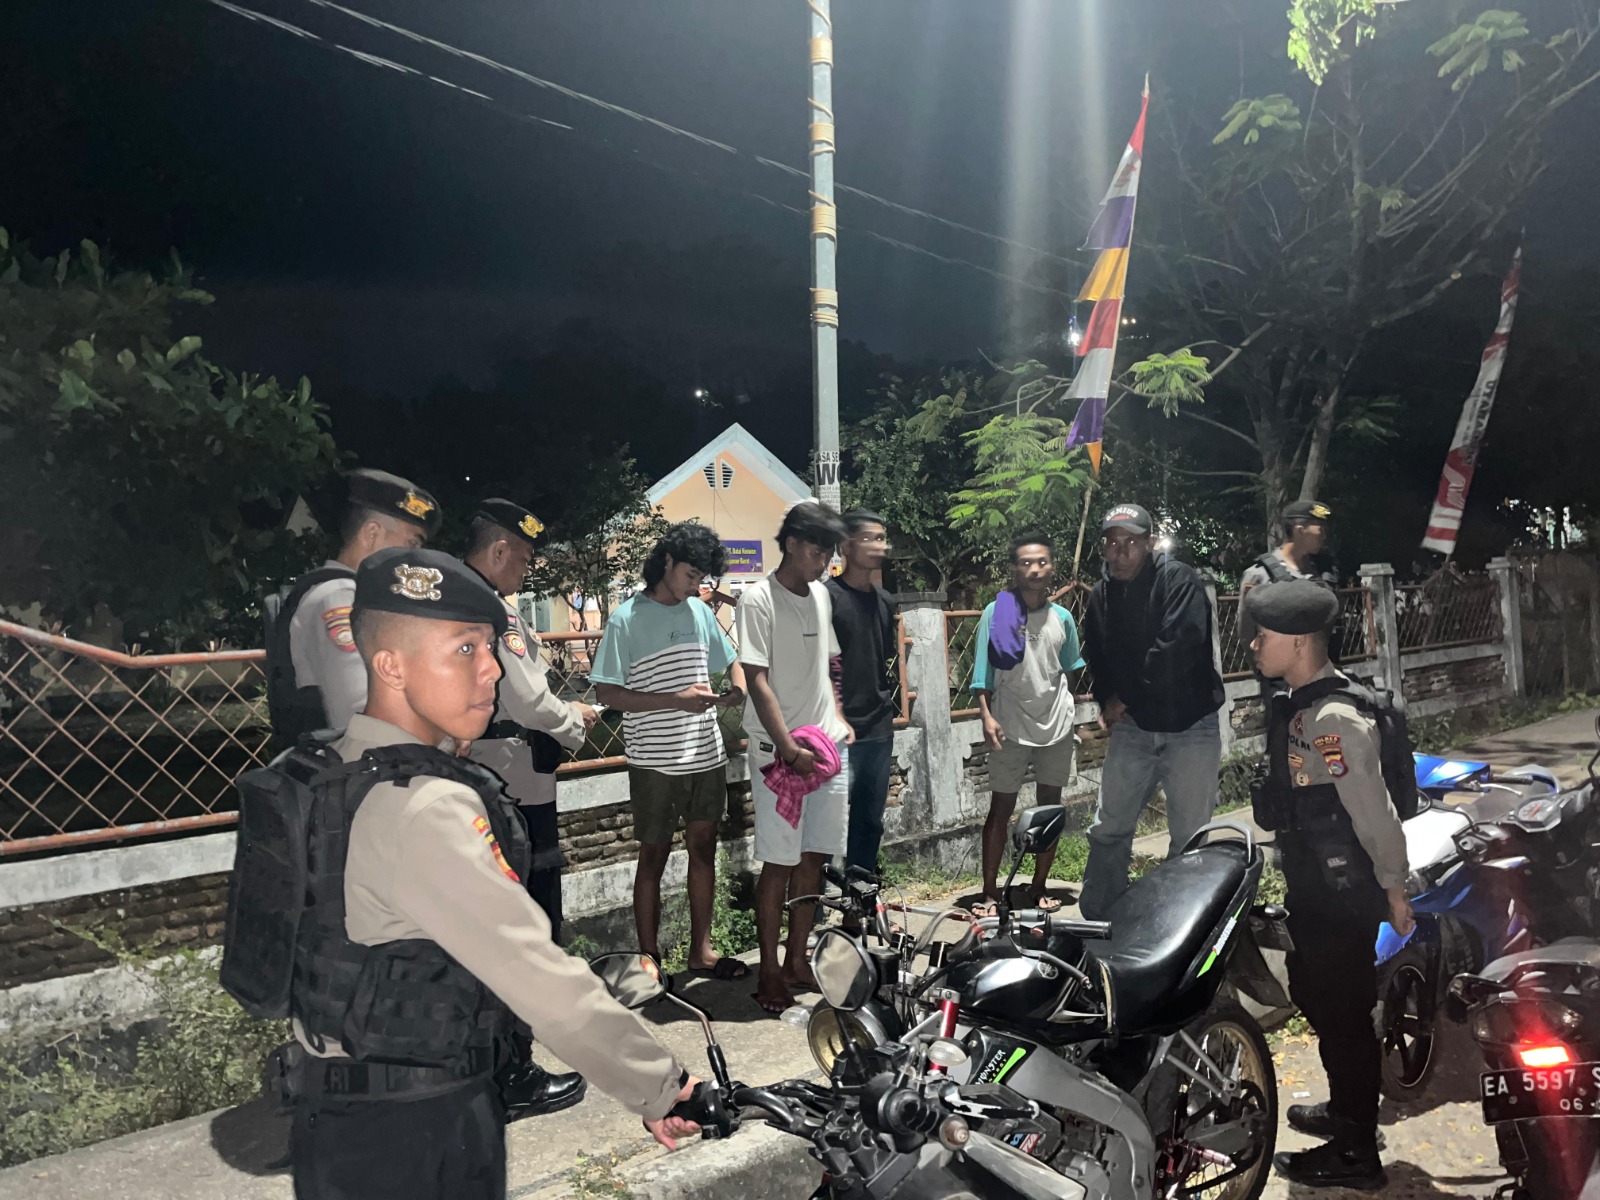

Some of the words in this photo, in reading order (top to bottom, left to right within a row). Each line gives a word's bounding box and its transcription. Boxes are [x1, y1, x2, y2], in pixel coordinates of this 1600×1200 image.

[816, 463, 840, 485] W
[1484, 1075, 1509, 1097] EA
[1522, 1068, 1576, 1092] 5597
[1560, 1097, 1583, 1111] 06
